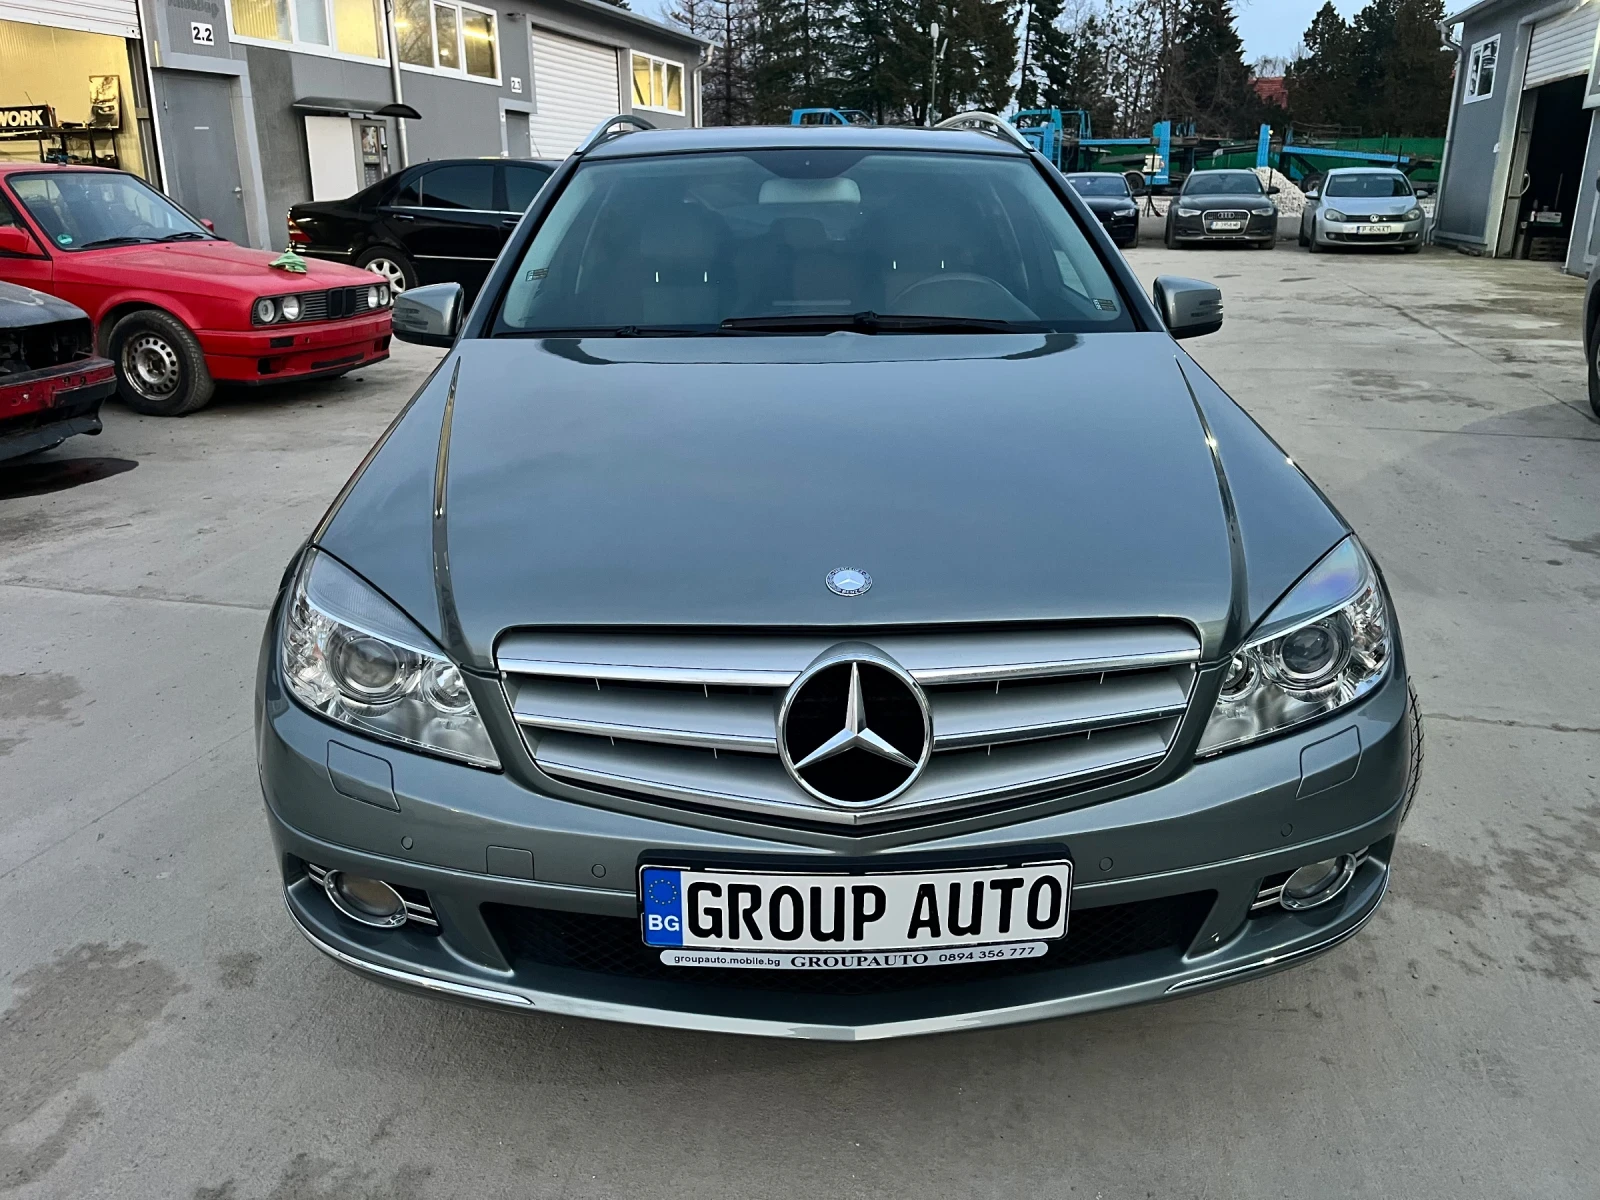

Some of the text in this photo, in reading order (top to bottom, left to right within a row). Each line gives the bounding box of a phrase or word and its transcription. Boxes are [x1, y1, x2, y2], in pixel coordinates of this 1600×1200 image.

[193, 26, 213, 42] 2.2
[687, 875, 1062, 942] GROUP AUTO
[648, 914, 680, 931] BG
[674, 946, 1035, 968] groupauto.mobile.bg GROUPAUTO 0894 356 777
